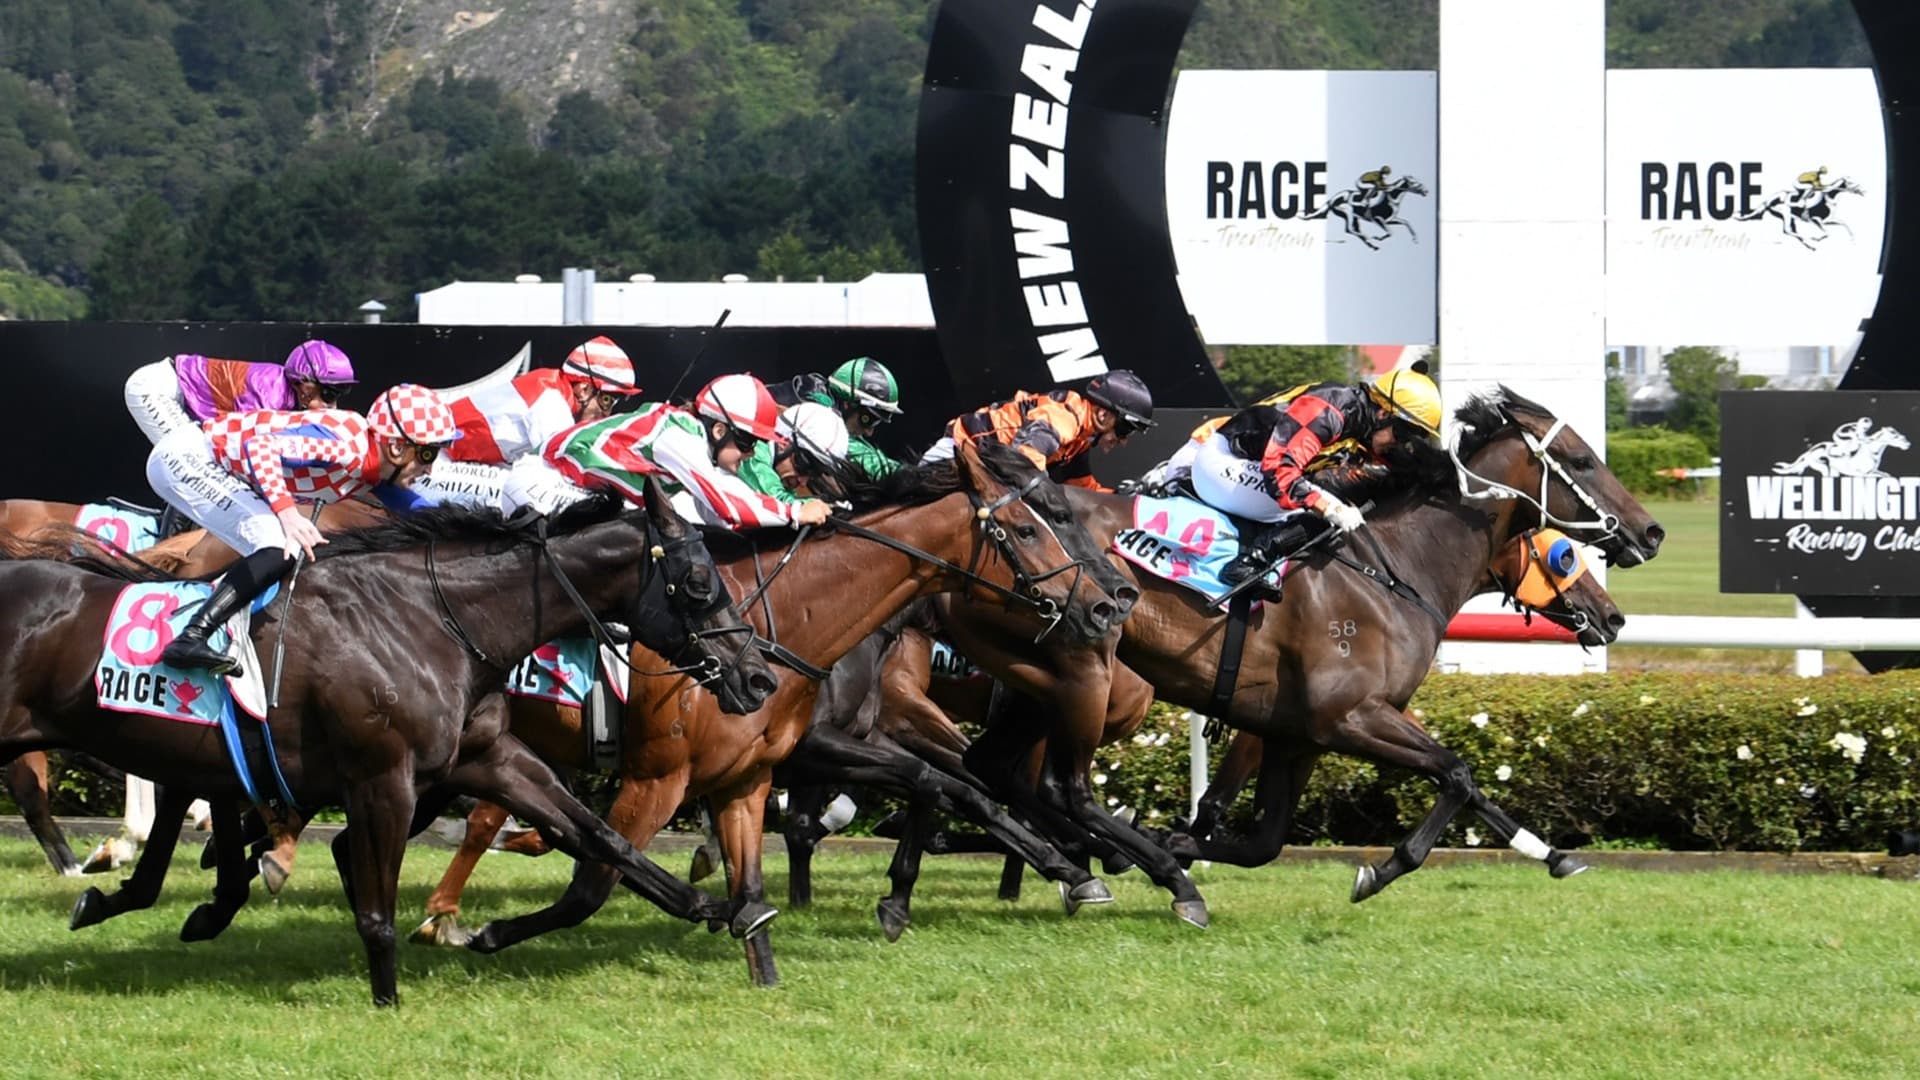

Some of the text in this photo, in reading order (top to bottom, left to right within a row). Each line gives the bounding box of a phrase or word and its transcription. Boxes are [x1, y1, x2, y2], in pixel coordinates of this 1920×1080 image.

[1009, 0, 1109, 383] NEW ZEAL
[1207, 161, 1327, 219] RACE
[1641, 162, 1763, 220] RACE
[1747, 476, 1920, 520] WELLINGT
[1786, 523, 1867, 561] Racing
[110, 593, 179, 667] 8
[1328, 619, 1357, 638] 58
[1338, 640, 1350, 658] 9
[101, 667, 168, 707] RACE
